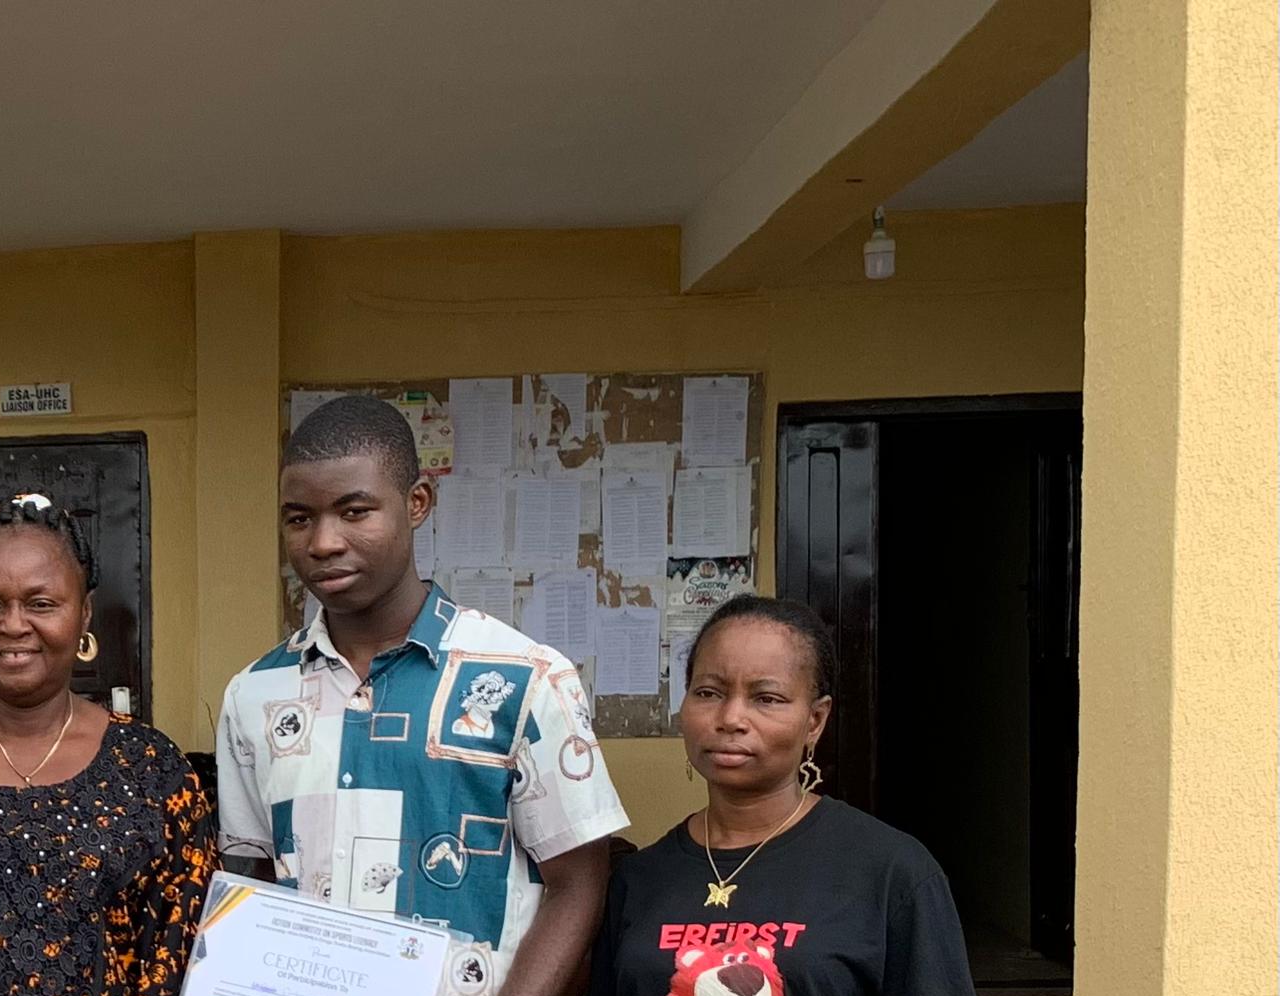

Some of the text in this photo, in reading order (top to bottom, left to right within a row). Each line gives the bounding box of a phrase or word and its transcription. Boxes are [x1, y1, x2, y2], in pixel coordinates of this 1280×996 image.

[8, 387, 60, 400] ESA-UHC
[1, 399, 67, 413] LIAISON OFFICE
[263, 951, 370, 988] CERTIFICATE
